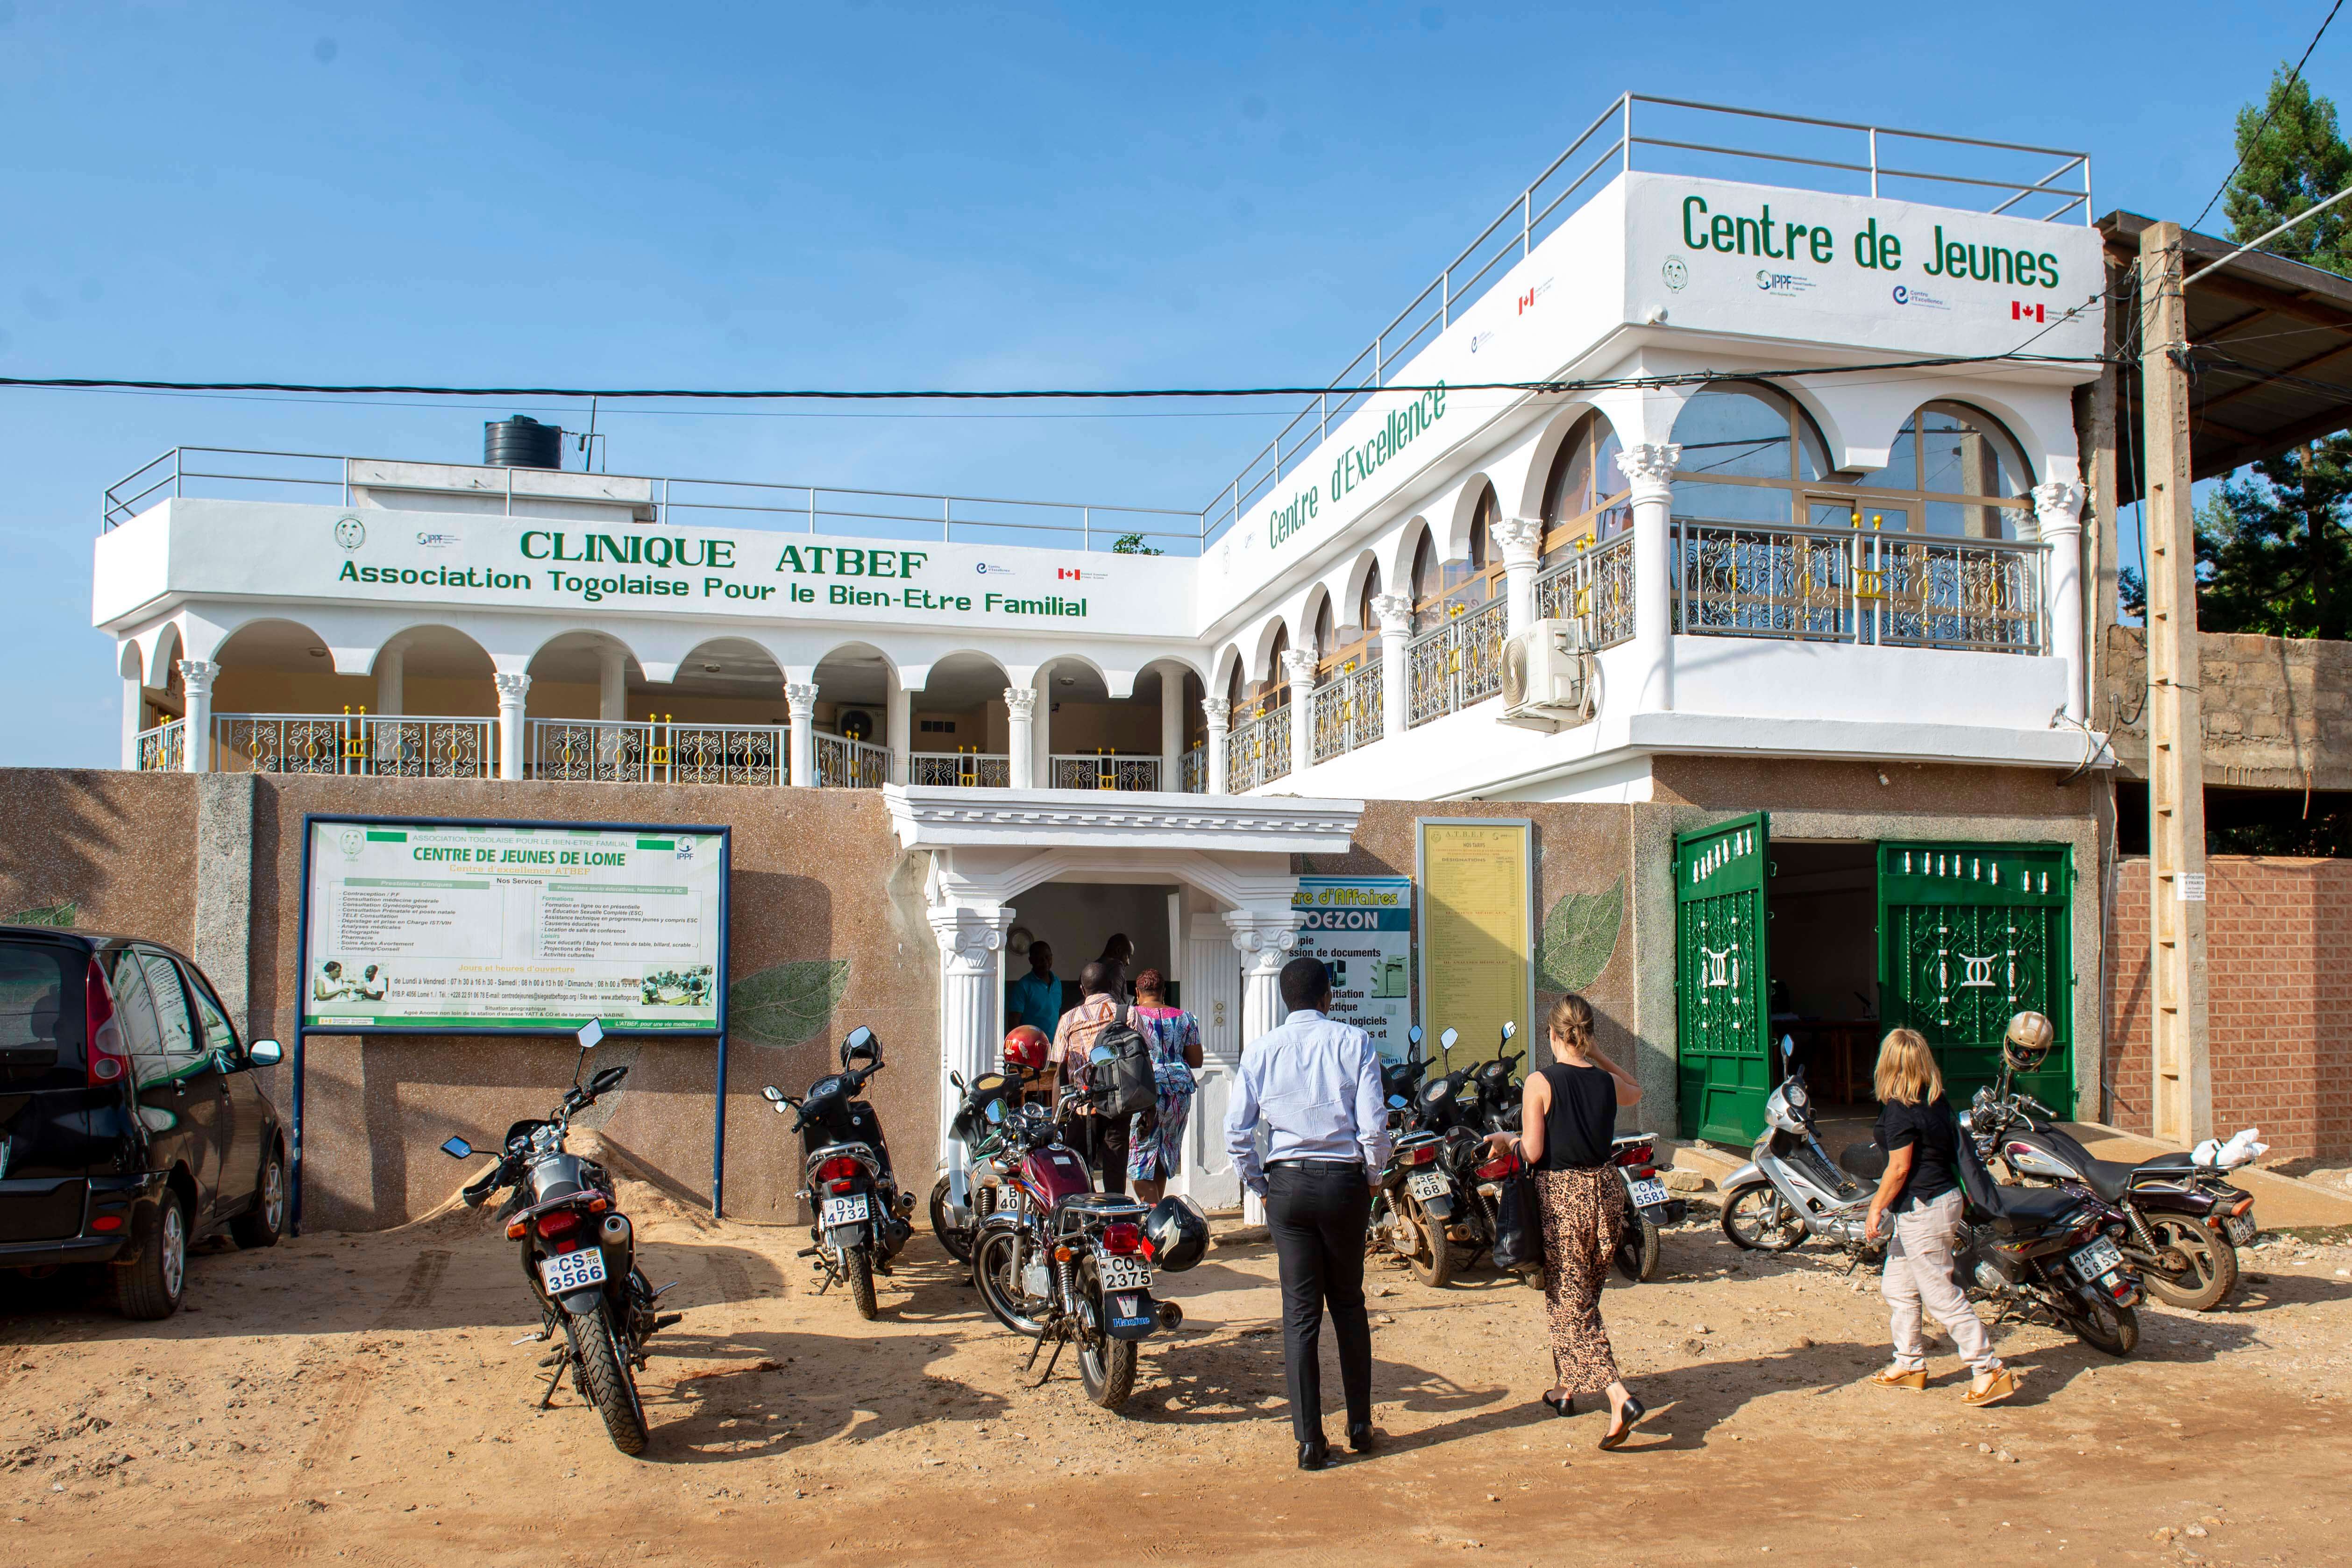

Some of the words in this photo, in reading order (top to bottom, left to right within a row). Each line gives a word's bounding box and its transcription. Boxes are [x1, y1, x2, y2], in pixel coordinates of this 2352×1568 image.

[1684, 197, 1833, 262] Centre
[1856, 218, 1901, 269] de
[1925, 226, 2058, 286] Jeunes
[1772, 274, 1791, 289] IPPF
[1271, 486, 1317, 547] Centre
[1332, 380, 1445, 501] d'Excellence
[428, 534, 443, 543] IPPF
[521, 531, 735, 568] CLINIQUE
[776, 545, 927, 578] ATBEF
[339, 561, 530, 589] Association
[547, 571, 689, 601] Togolaise
[705, 577, 775, 599] Pour
[791, 583, 814, 603] le
[830, 585, 971, 610] Bien-Etre
[986, 593, 1087, 616] Familial
[413, 847, 471, 862] CENTRE
[476, 849, 496, 863] DE
[501, 850, 555, 864] JEUNES
[561, 851, 580, 865] DE
[585, 852, 626, 866] LOME
[1318, 888, 1398, 905] d'Affaires
[1289, 949, 1313, 957] ssion
[1316, 948, 1328, 957] de
[1331, 949, 1381, 958] documents
[1329, 1003, 1358, 1013] atique
[1350, 1016, 1387, 1027] logiciels
[1378, 1029, 1387, 1038] et
[1638, 1180, 1655, 1192] CX
[836, 1197, 855, 1211] DJ
[1636, 1190, 1668, 1205] 5581
[828, 1207, 867, 1223] 4732
[559, 1254, 585, 1271] CS
[1112, 1256, 1135, 1272] CO
[2075, 1247, 2094, 1267] 2AF
[2084, 1251, 2118, 1277] 9853
[549, 1266, 603, 1291] 3566
[1105, 1270, 1151, 1289] 2375
[1113, 1317, 1150, 1327] Haojue
